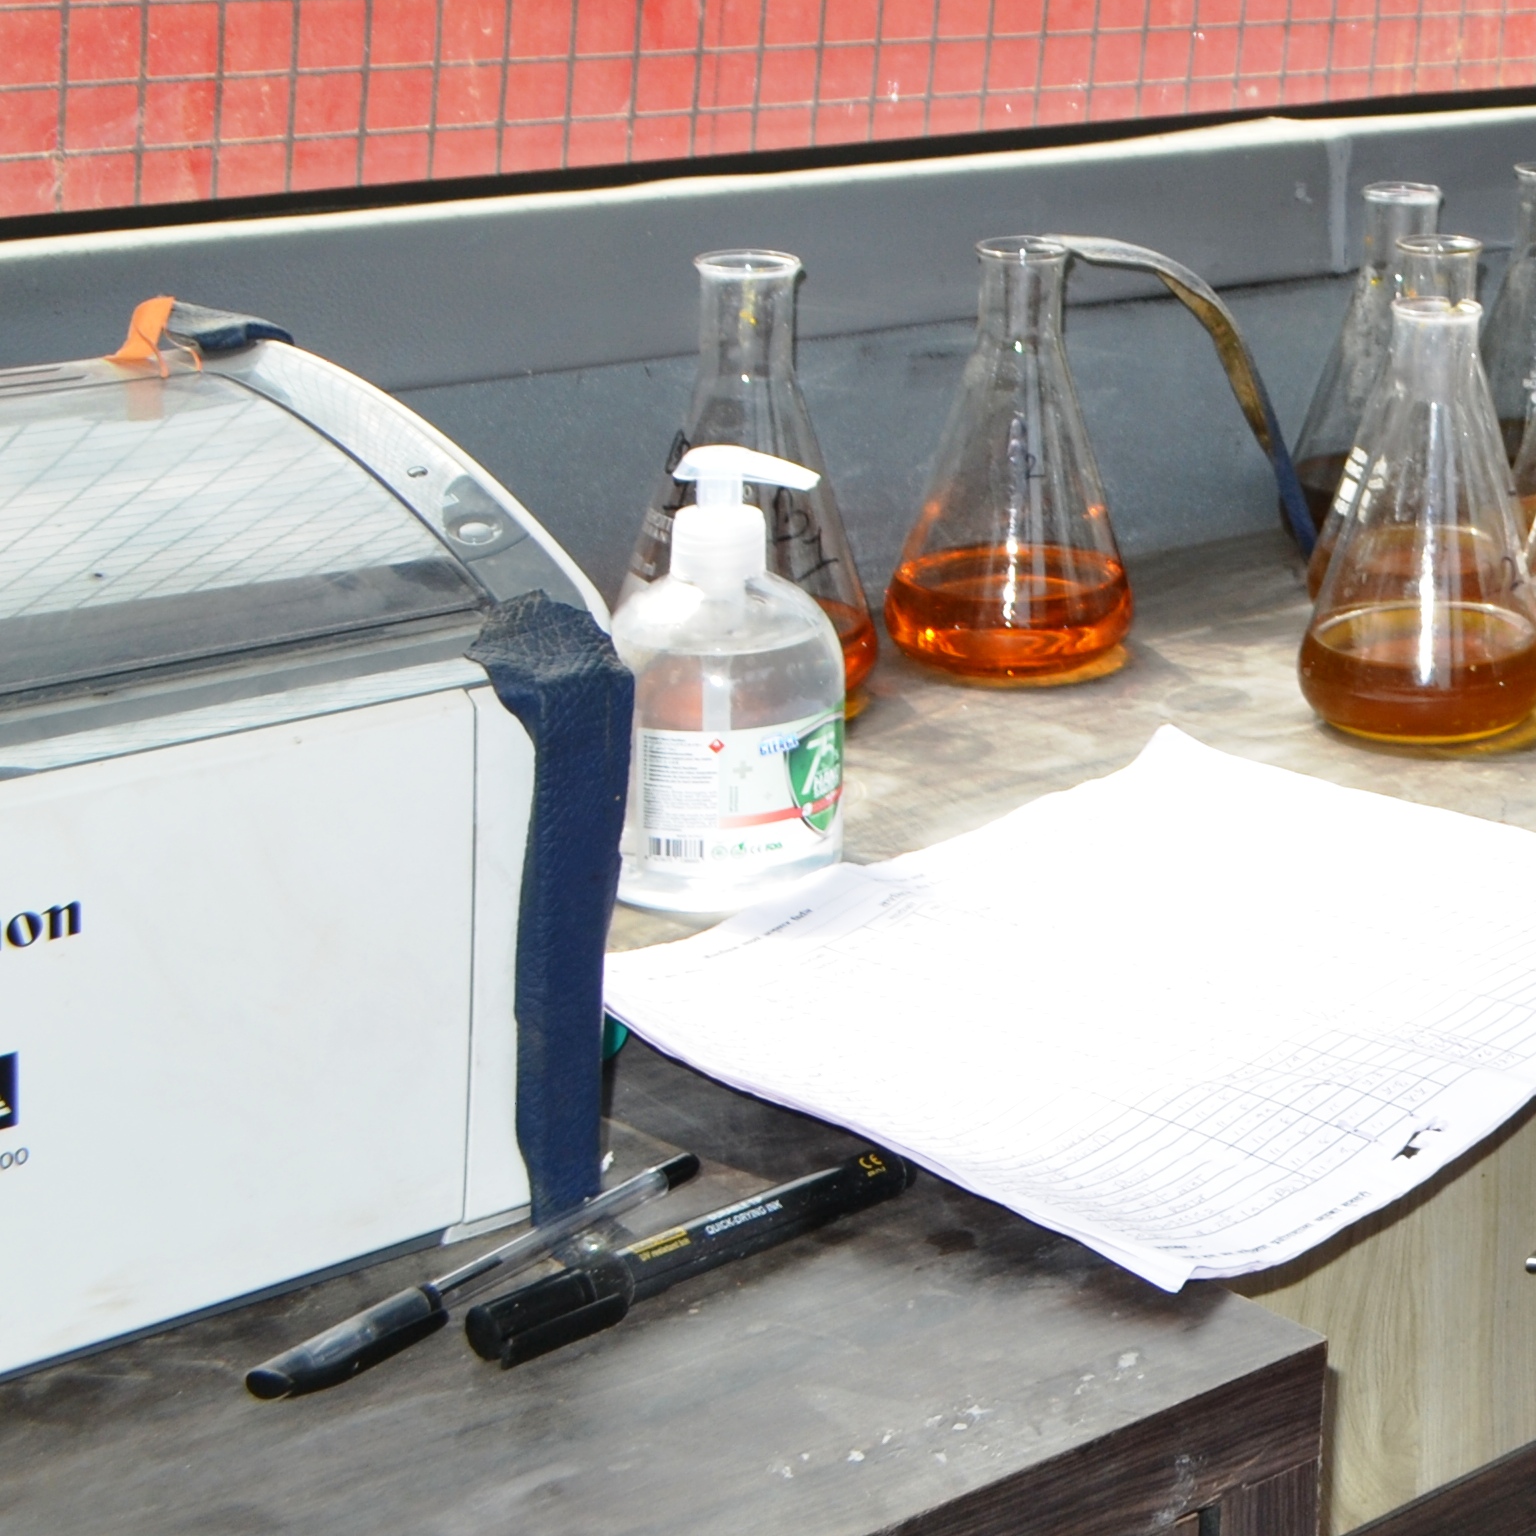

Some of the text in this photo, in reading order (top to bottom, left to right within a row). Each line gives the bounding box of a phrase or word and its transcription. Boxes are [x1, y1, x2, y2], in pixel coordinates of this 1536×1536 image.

[0, 900, 81, 951] on
[705, 1203, 767, 1235] QUICK-DRYING
[765, 1199, 784, 1214] INK
